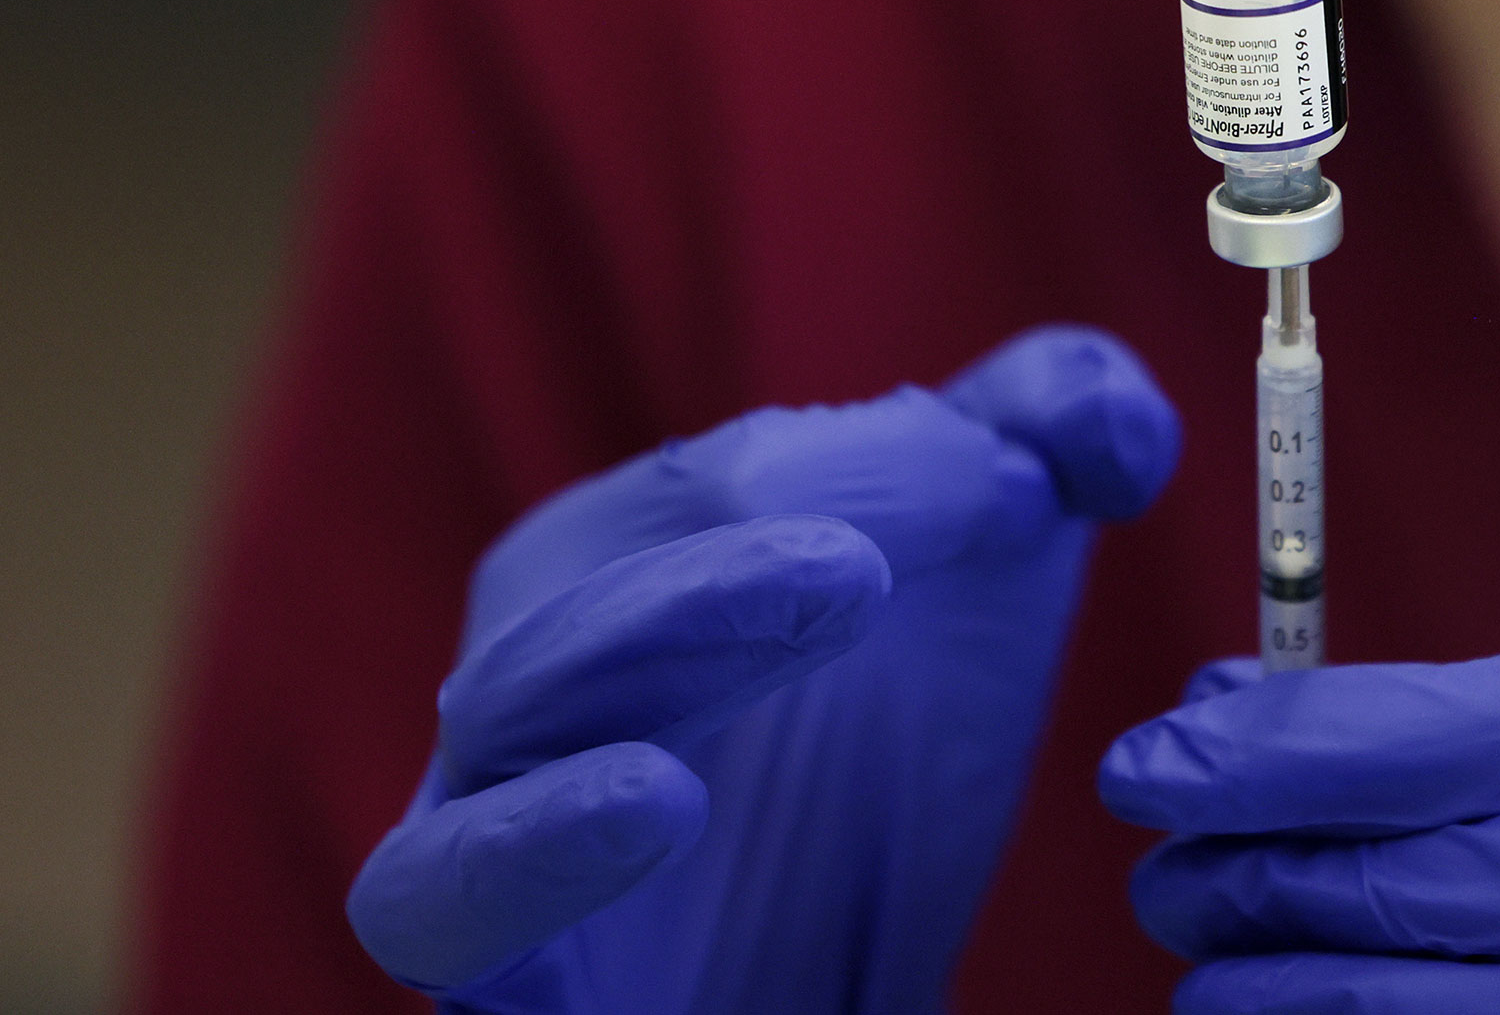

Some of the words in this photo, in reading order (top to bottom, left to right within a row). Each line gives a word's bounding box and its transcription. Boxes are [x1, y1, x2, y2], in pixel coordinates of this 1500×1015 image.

[1199, 34, 1213, 45] and
[1215, 38, 1236, 48] date
[1239, 39, 1277, 48] Dilution
[1209, 50, 1234, 62] when
[1237, 52, 1278, 63] dilution
[1201, 58, 1237, 73] BEFORE
[1240, 64, 1279, 74] DILUTE
[1211, 76, 1237, 87] under
[1263, 78, 1280, 87] For
[1294, 28, 1315, 131] PAA173696
[1202, 87, 1261, 102] intramuscular
[1264, 92, 1281, 101] For
[1196, 97, 1208, 110] vial
[1210, 101, 1251, 118] dilution,
[1320, 85, 1331, 125] LOT/EXP
[1254, 105, 1283, 117] After
[1192, 110, 1284, 139] Pfizer-BioNTech
[1270, 430, 1302, 454] 0.1
[1271, 480, 1305, 503] 0.2
[1272, 529, 1306, 553] 0.3
[1273, 627, 1309, 652] 0.5
